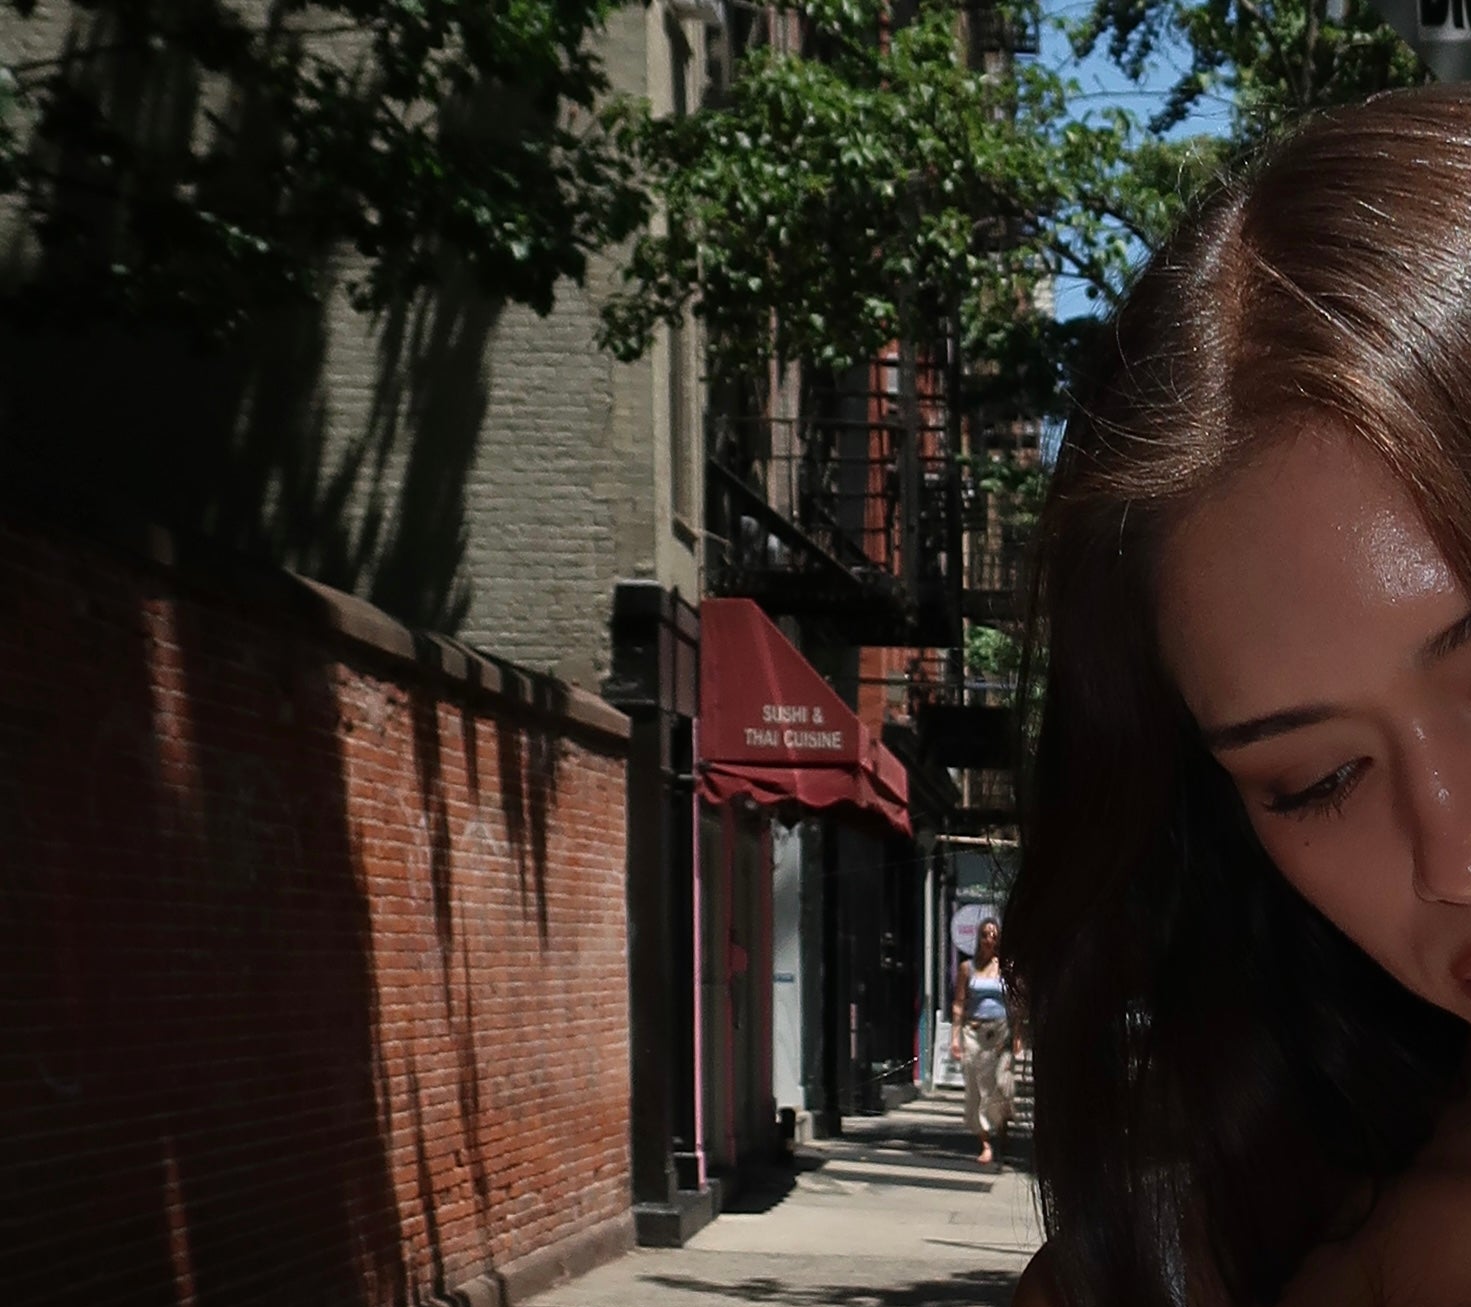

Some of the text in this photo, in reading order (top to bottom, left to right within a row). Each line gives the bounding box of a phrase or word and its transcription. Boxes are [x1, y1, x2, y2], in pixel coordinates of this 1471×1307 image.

[763, 705, 824, 723] SUSHI &
[745, 729, 841, 748] THAI CUISINE
